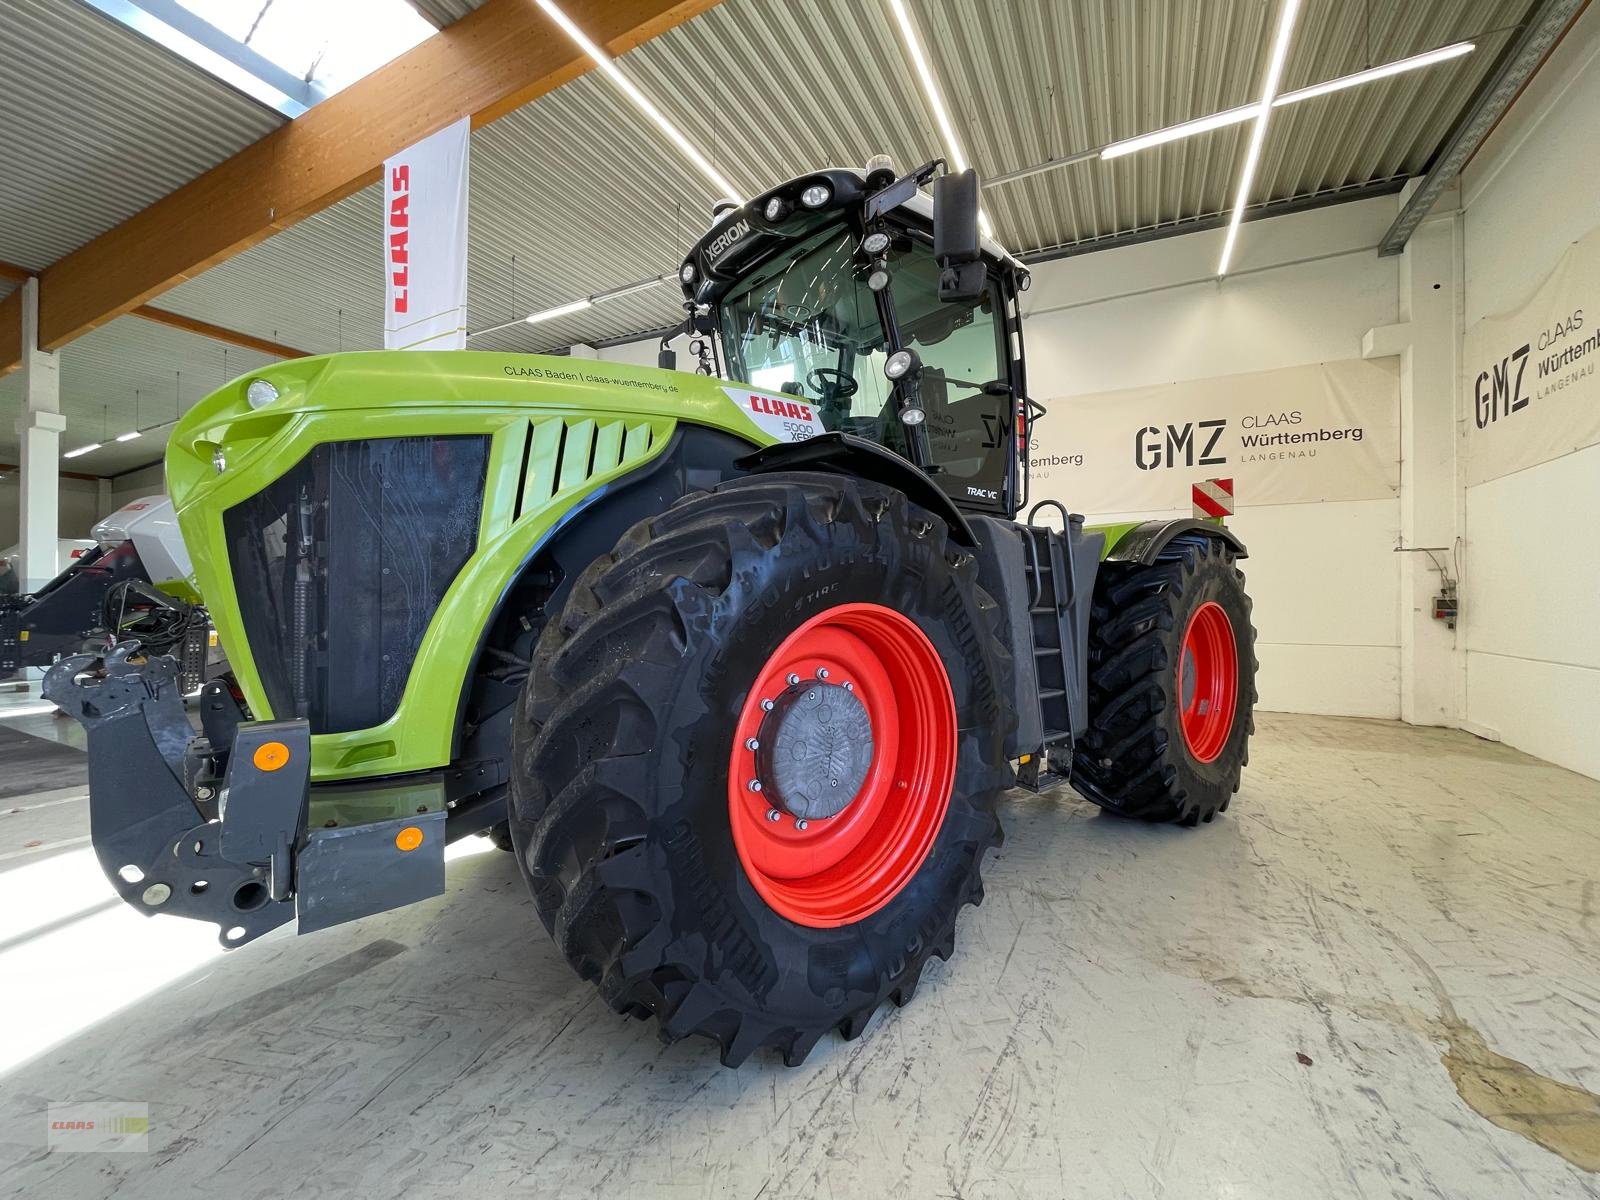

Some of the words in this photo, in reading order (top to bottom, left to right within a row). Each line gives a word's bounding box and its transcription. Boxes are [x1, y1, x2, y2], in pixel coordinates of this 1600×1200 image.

[390, 165, 409, 313] CLAAS
[705, 218, 750, 261] XERION
[1538, 309, 1583, 351] CLAAS
[504, 366, 542, 378] CLAAS
[546, 369, 577, 381] Baden
[1475, 343, 1530, 429] GMZ
[1537, 361, 1594, 400] LANGENAU
[750, 395, 812, 421] CLAAS
[1241, 411, 1302, 429] CLAAS
[784, 422, 813, 434] 5000
[1241, 428, 1363, 447] Württemberg
[1135, 419, 1227, 471] GMZ
[1241, 449, 1317, 463] LANGENAU
[967, 487, 986, 498] TRAC
[988, 491, 997, 500] VC
